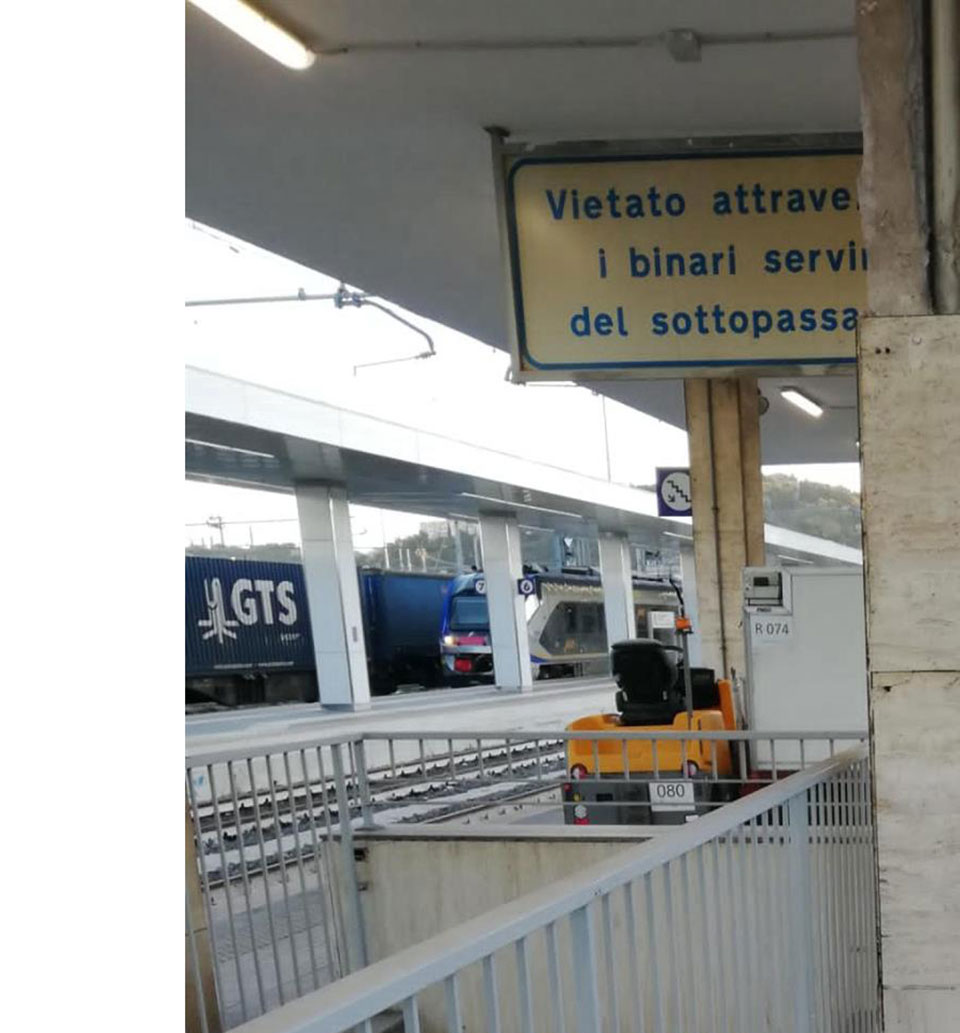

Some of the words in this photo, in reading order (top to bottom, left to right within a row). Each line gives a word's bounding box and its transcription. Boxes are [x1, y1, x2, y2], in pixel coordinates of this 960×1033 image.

[546, 186, 686, 220] Vietato
[599, 248, 607, 278] i
[629, 245, 736, 278] binari
[570, 305, 628, 337] del
[231, 578, 297, 626] GTS
[755, 623, 763, 635] R
[766, 623, 789, 635] 074
[656, 783, 685, 798] 080
